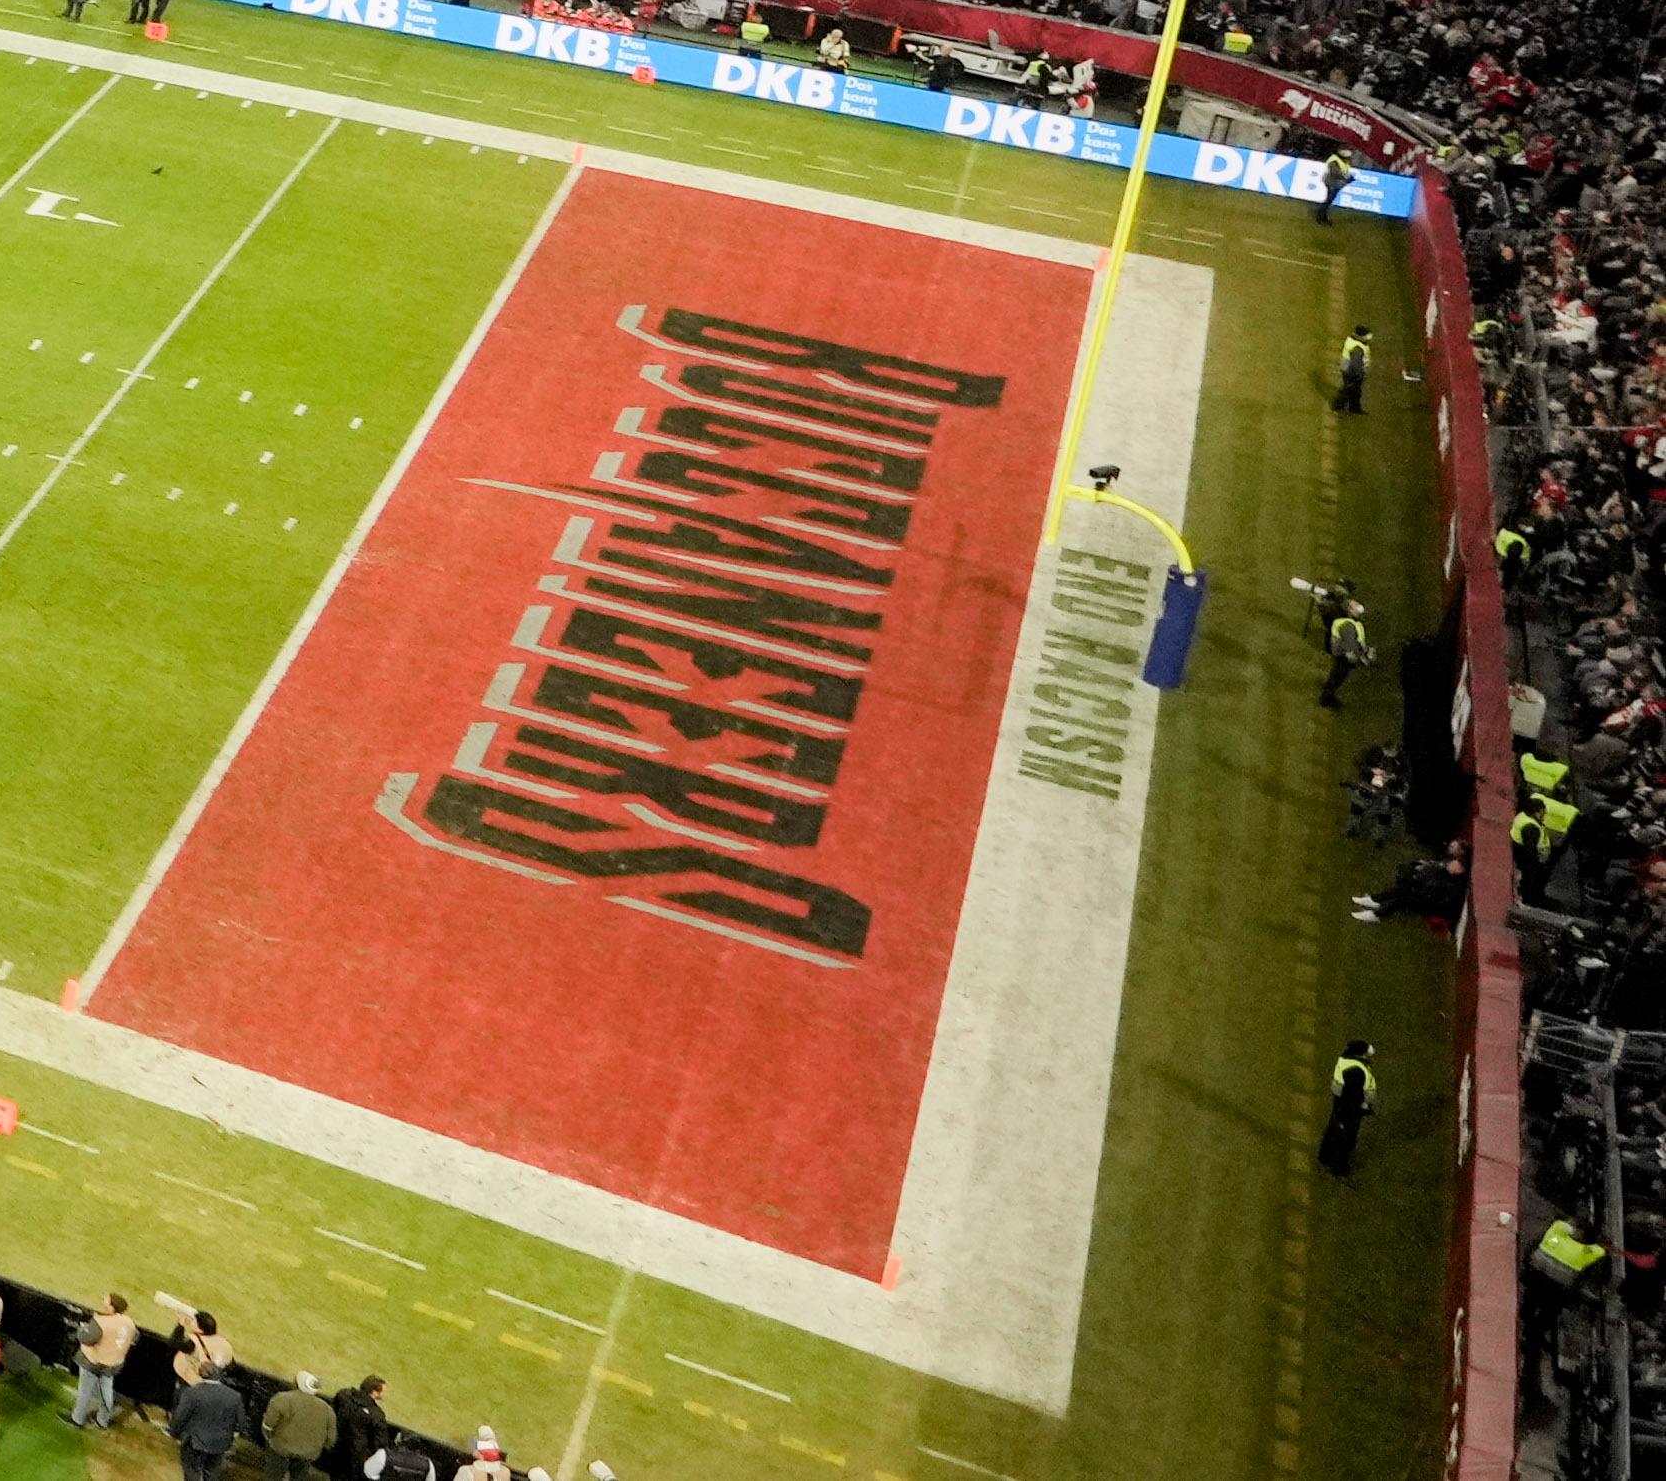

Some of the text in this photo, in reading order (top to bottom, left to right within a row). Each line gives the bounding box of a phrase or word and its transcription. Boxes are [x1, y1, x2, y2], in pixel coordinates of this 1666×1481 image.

[495, 17, 611, 70] DKB
[618, 35, 647, 52] Das
[712, 51, 836, 110] DKB
[844, 76, 874, 94] Das
[840, 102, 877, 120] Bank
[842, 90, 878, 106] kann
[943, 95, 1078, 157] DKB
[1086, 121, 1117, 138] Das
[1309, 100, 1372, 142] BUCCANEERS
[1081, 148, 1121, 165] Bank
[1084, 135, 1122, 151] kann
[1193, 141, 1328, 204] DKB
[373, 303, 1008, 969] BUCCANEERS
[1016, 619, 1144, 802] RACISM
